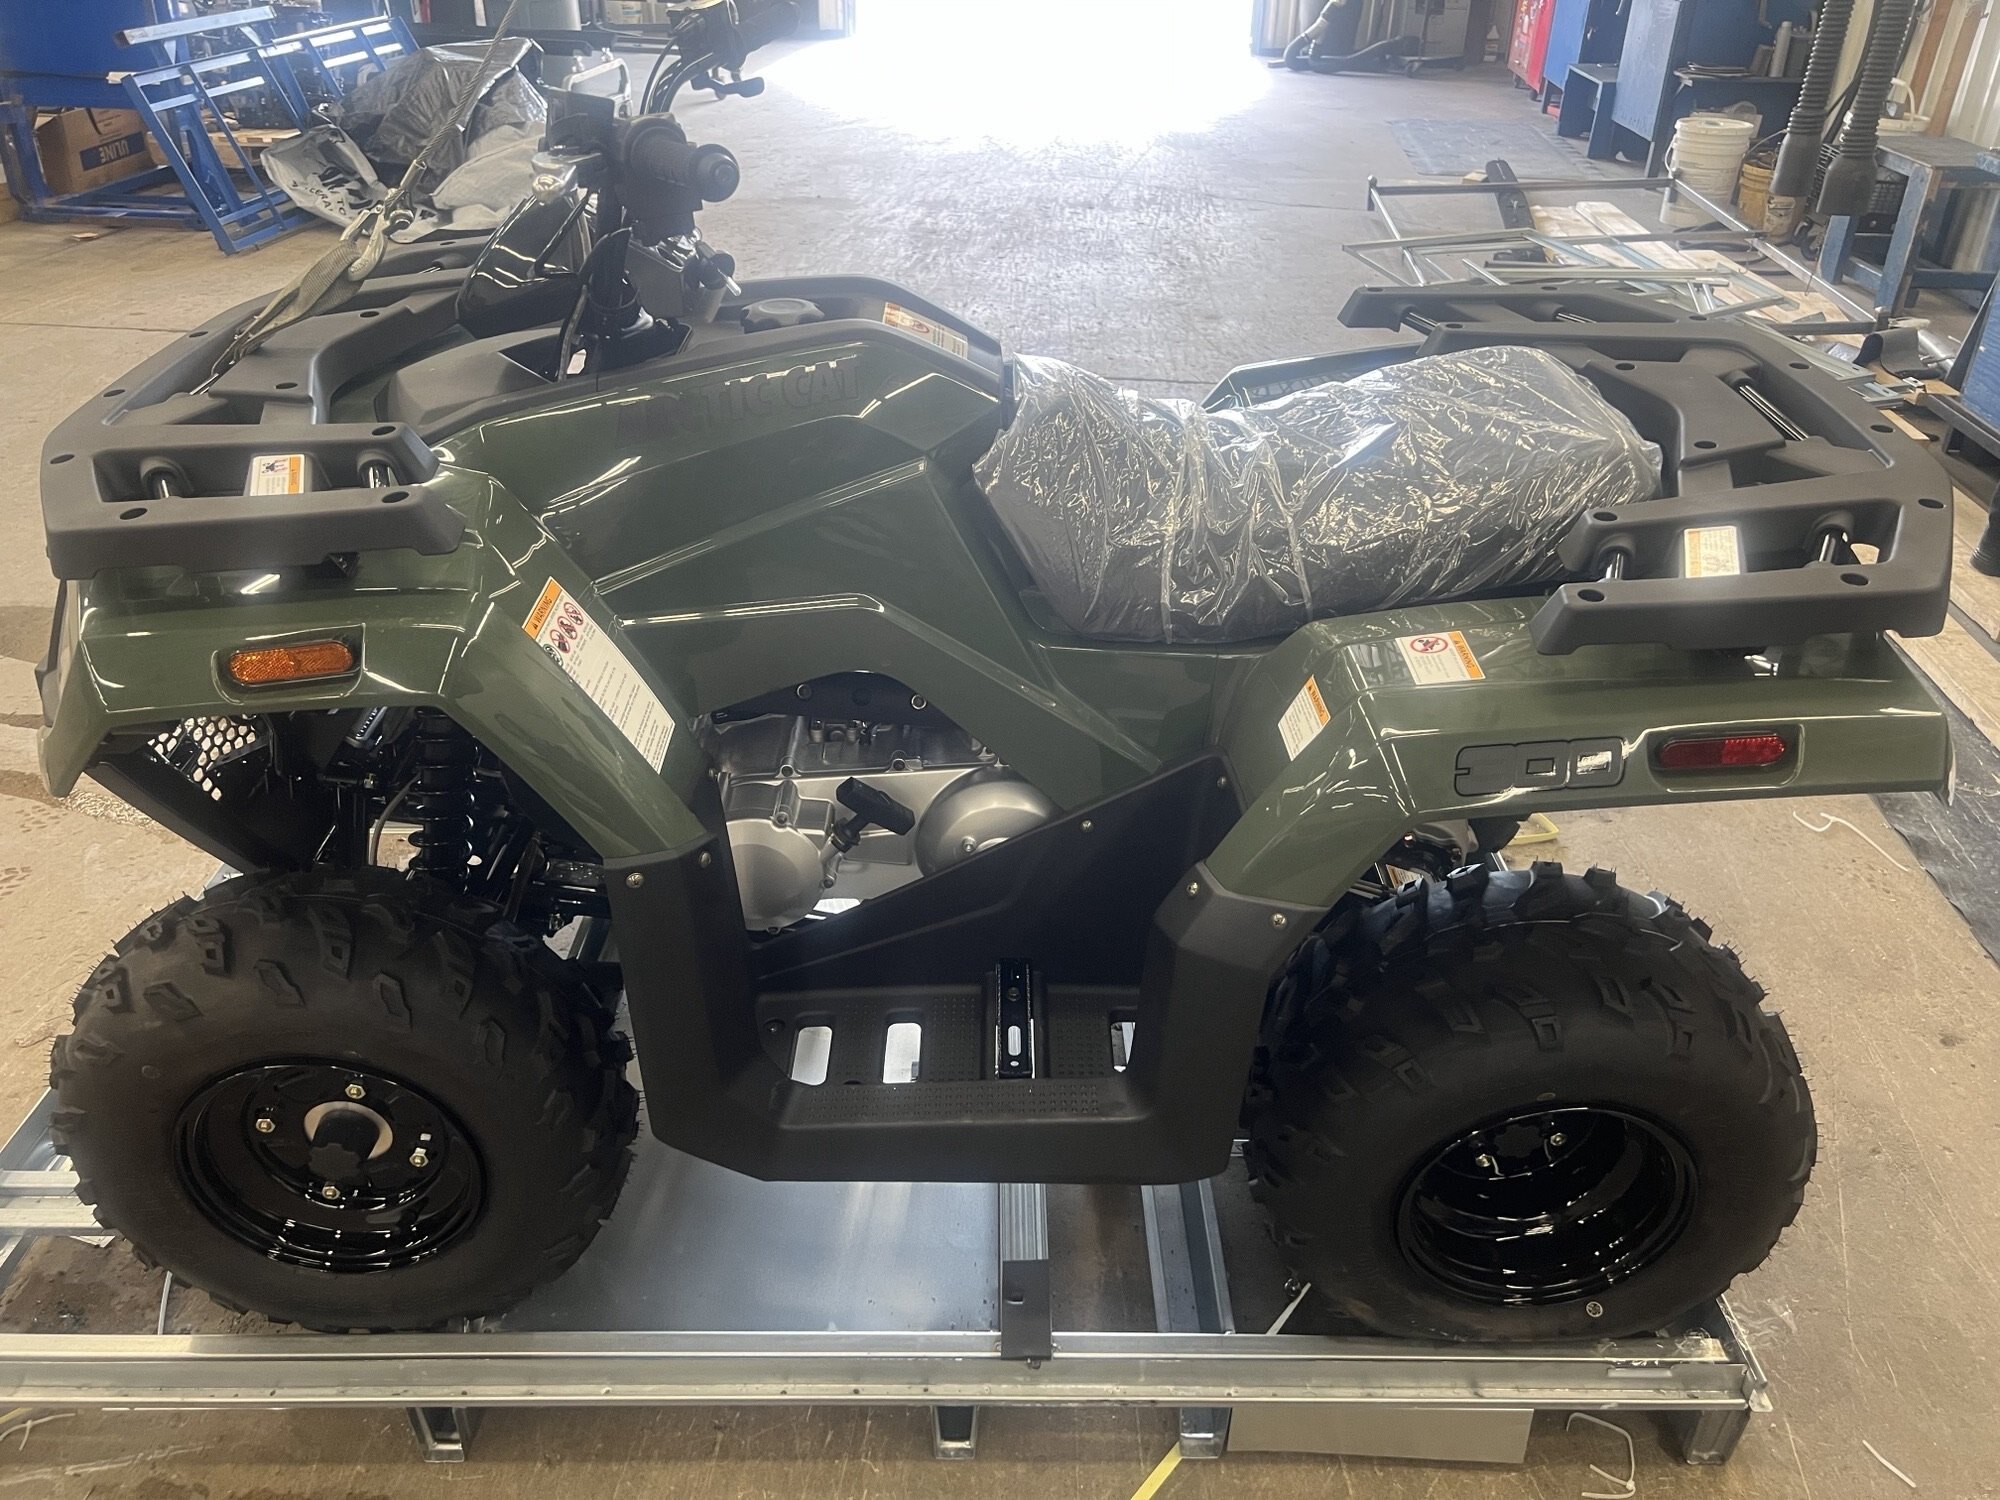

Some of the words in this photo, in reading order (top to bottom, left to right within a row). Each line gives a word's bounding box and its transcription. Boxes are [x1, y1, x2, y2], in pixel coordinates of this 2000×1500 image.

[99, 139, 129, 163] ULINE
[783, 354, 861, 409] CAT
[533, 595, 553, 624] WARNING
